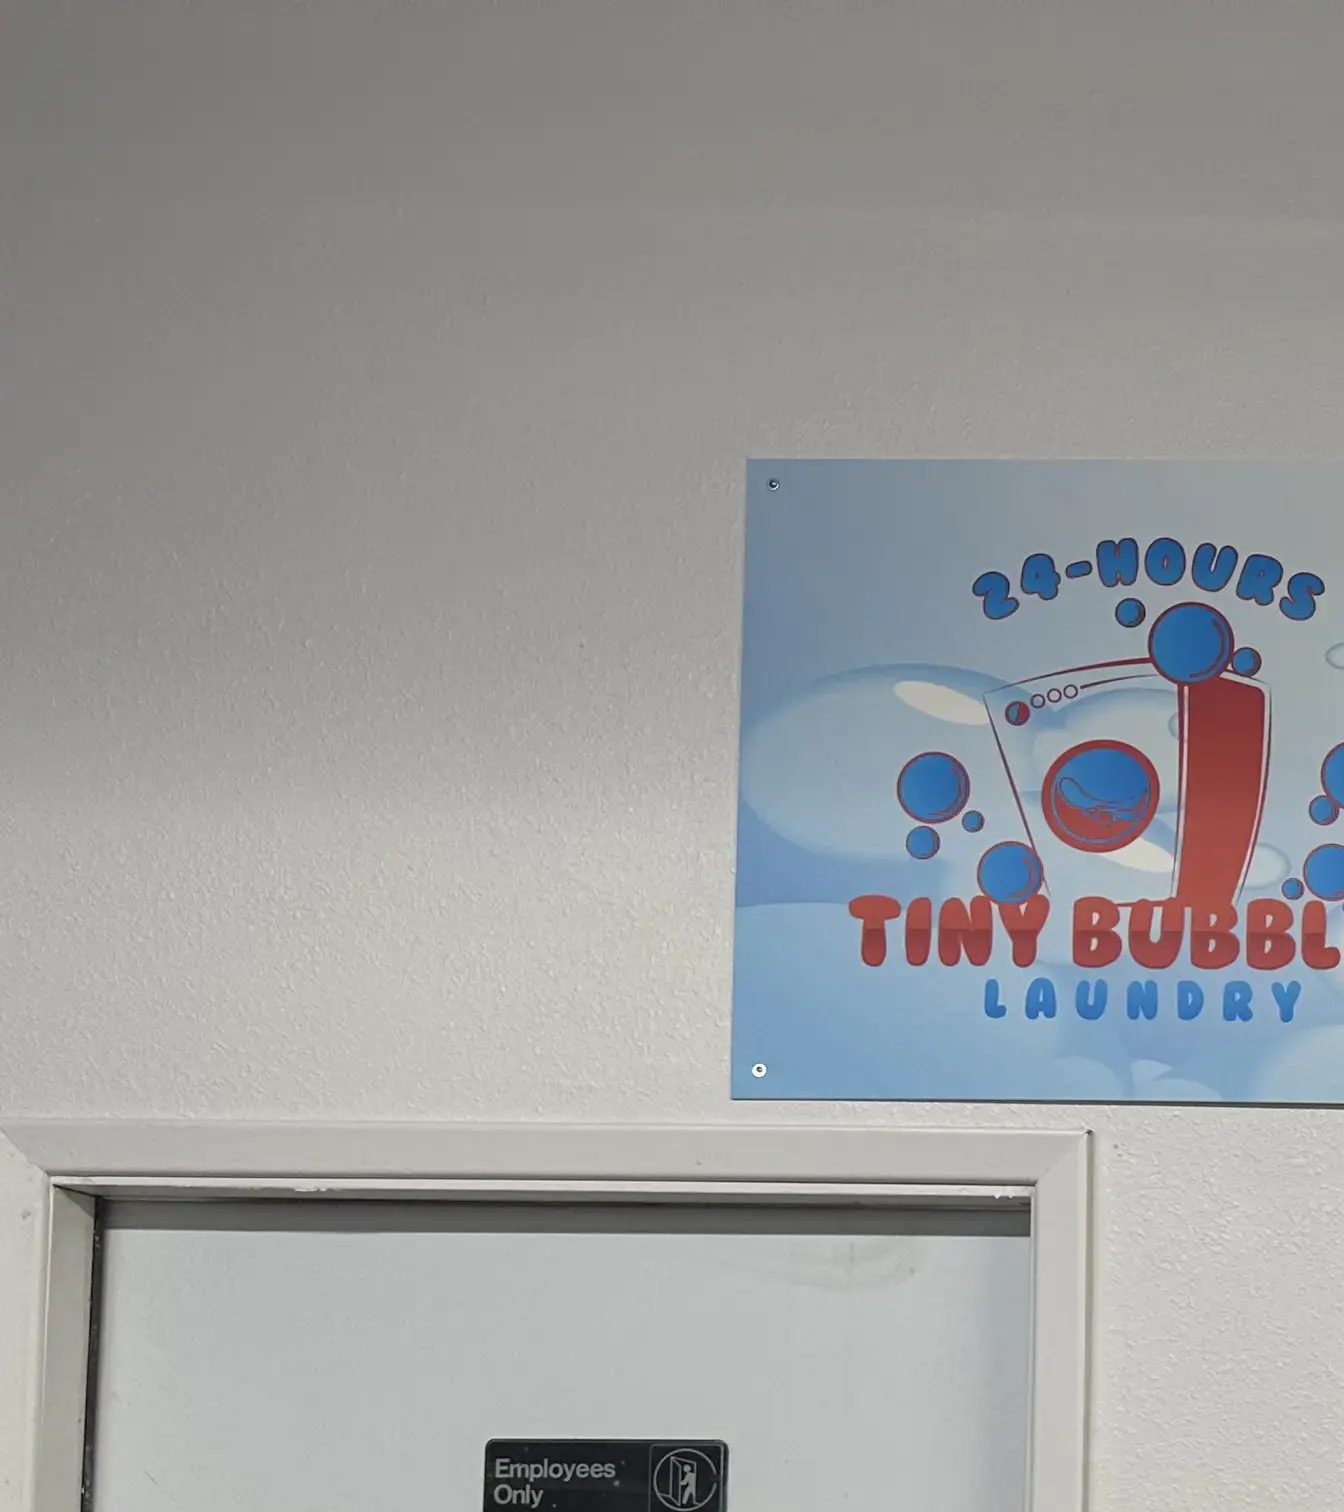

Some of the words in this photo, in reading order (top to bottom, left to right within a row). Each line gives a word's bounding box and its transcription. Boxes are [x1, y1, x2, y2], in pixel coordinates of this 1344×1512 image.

[972, 537, 1325, 621] 24-HOURS
[849, 894, 1050, 968] TINY
[984, 977, 1303, 1023] LAUNDRY
[494, 1458, 618, 1482] Employees
[493, 1483, 544, 1508] Only
